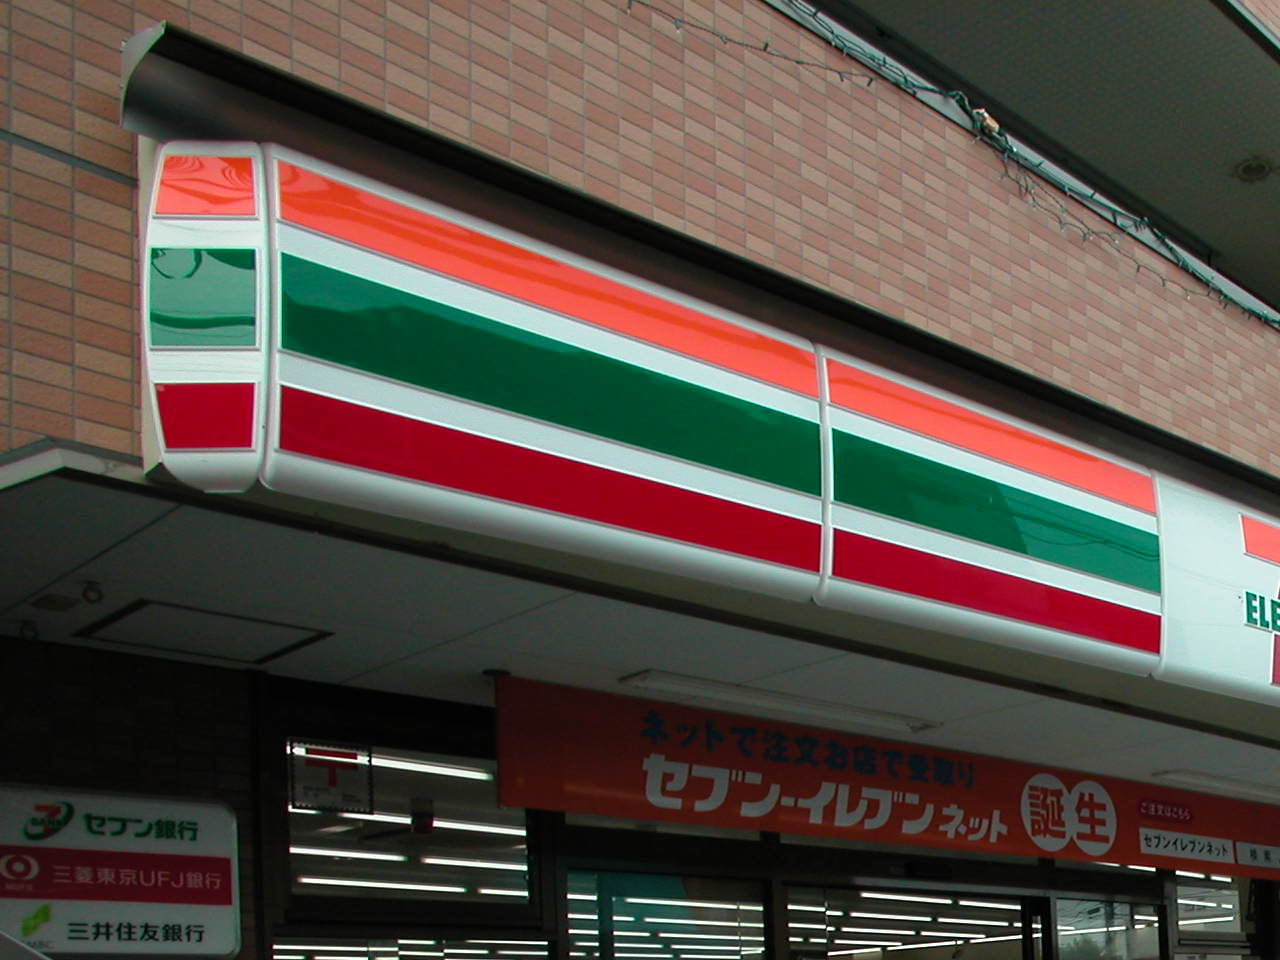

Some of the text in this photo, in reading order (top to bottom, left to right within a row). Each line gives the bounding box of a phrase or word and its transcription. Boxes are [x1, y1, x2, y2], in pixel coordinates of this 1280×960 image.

[639, 709, 977, 789] ネットで注文お店で受取り
[1028, 785, 1111, 845] 誕生
[1140, 802, 1191, 821] ご注文はこちら
[84, 813, 199, 842] セブン銀行
[1143, 834, 1229, 857] セブンイレブンネット
[53, 864, 222, 889] 三菱東京UFJ銀行
[67, 922, 206, 943] 三井住友銀行
